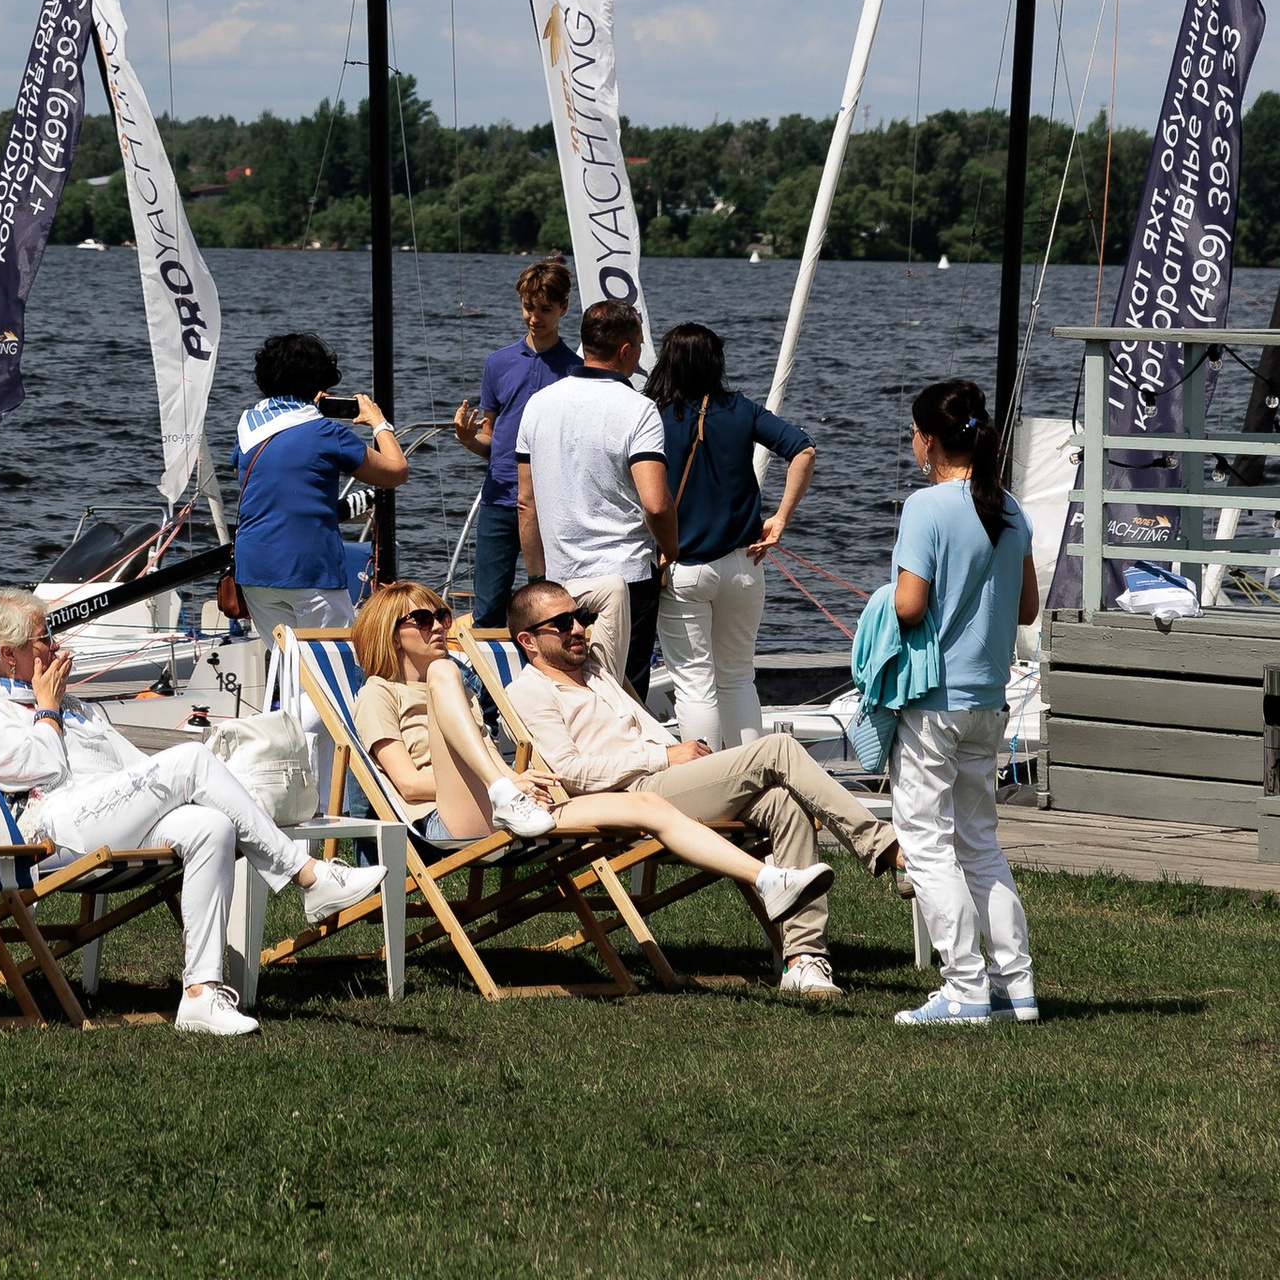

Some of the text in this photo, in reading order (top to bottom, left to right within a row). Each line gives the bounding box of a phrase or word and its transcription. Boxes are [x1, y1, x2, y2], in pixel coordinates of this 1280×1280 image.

[52, 15, 82, 82] 393
[37, 87, 79, 173] (499)
[564, 6, 639, 308] OYACHTING
[29, 174, 54, 216] +7
[1187, 24, 1242, 323] (499) 393 31 33
[1143, 187, 1171, 254] яхт,
[1070, 512, 1170, 542] PACHTING
[216, 672, 238, 693] 18
